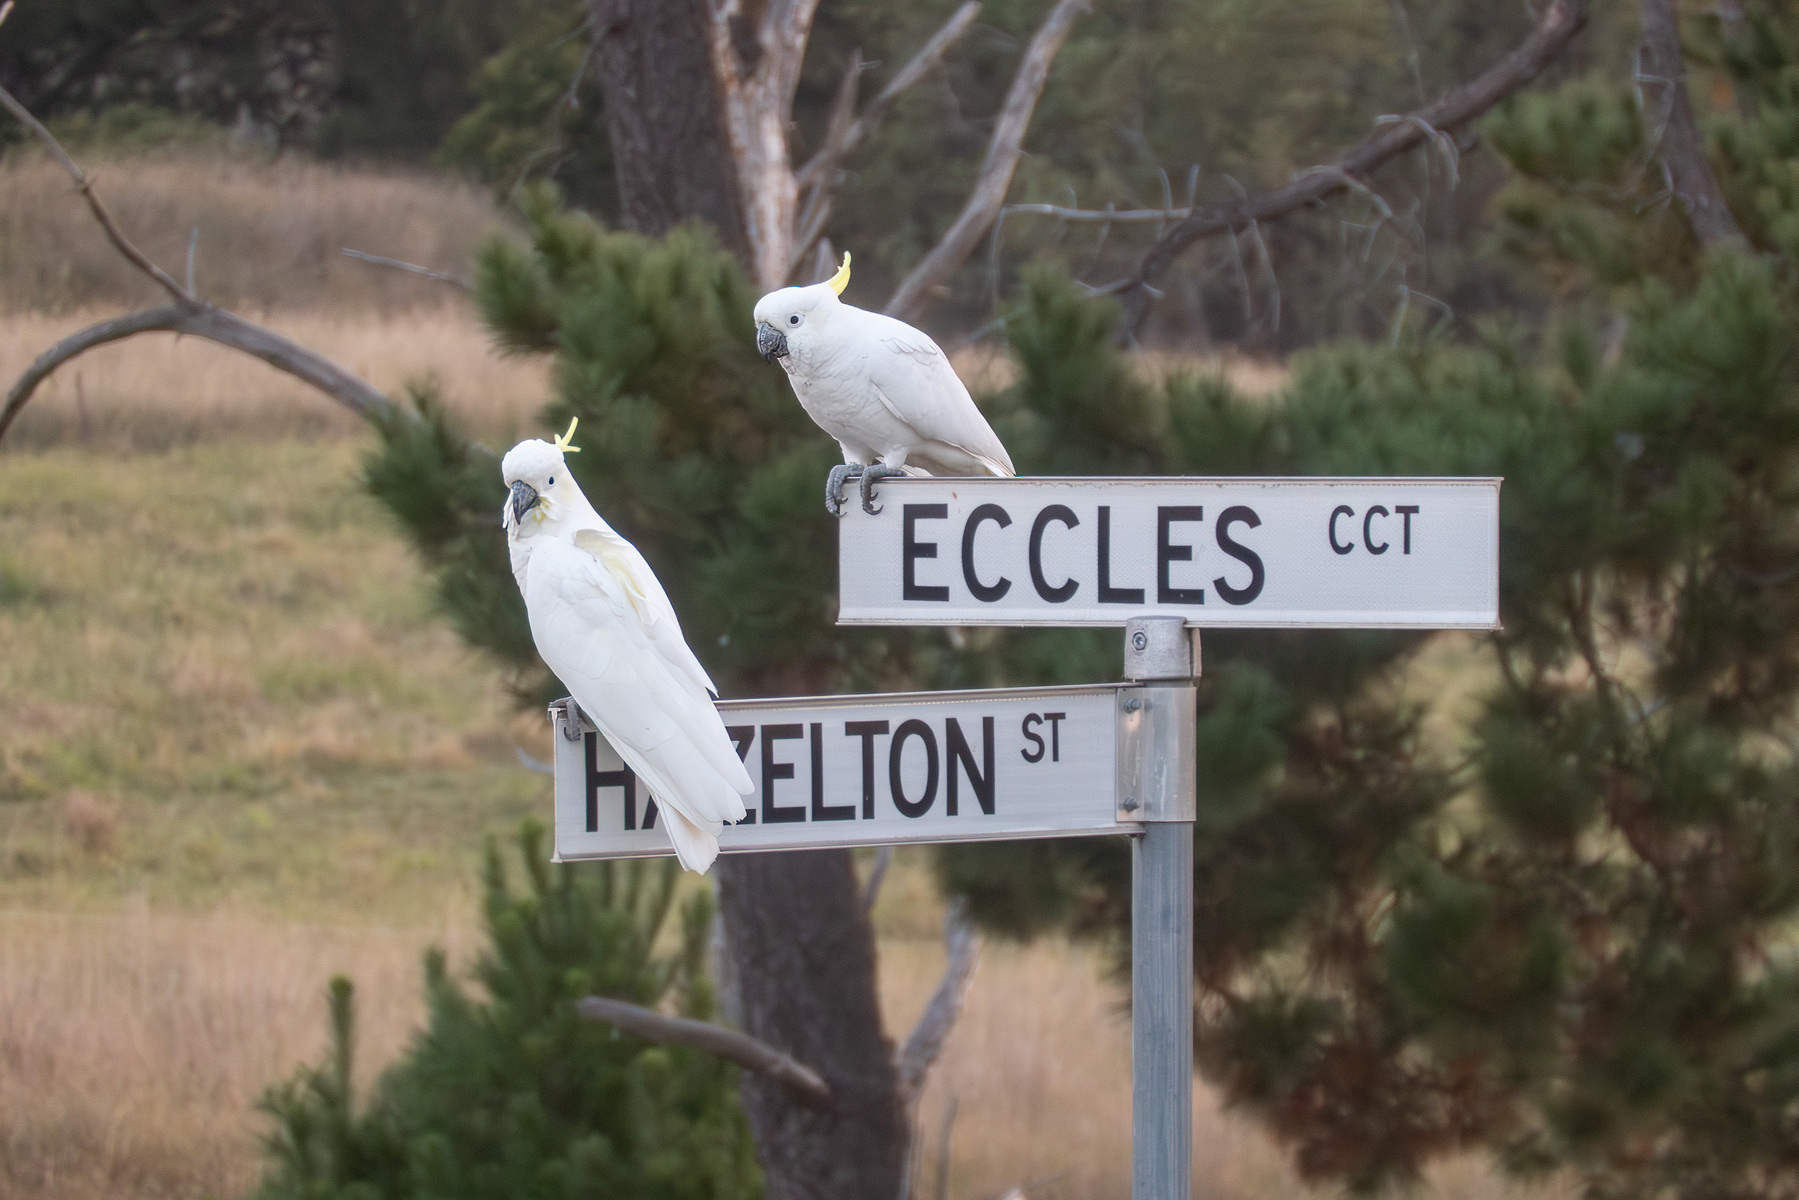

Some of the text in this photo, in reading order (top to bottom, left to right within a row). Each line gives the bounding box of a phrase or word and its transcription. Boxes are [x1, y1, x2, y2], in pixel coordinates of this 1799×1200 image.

[902, 503, 1420, 606] ECCLES CCT
[584, 711, 1066, 833] HELTON ST
